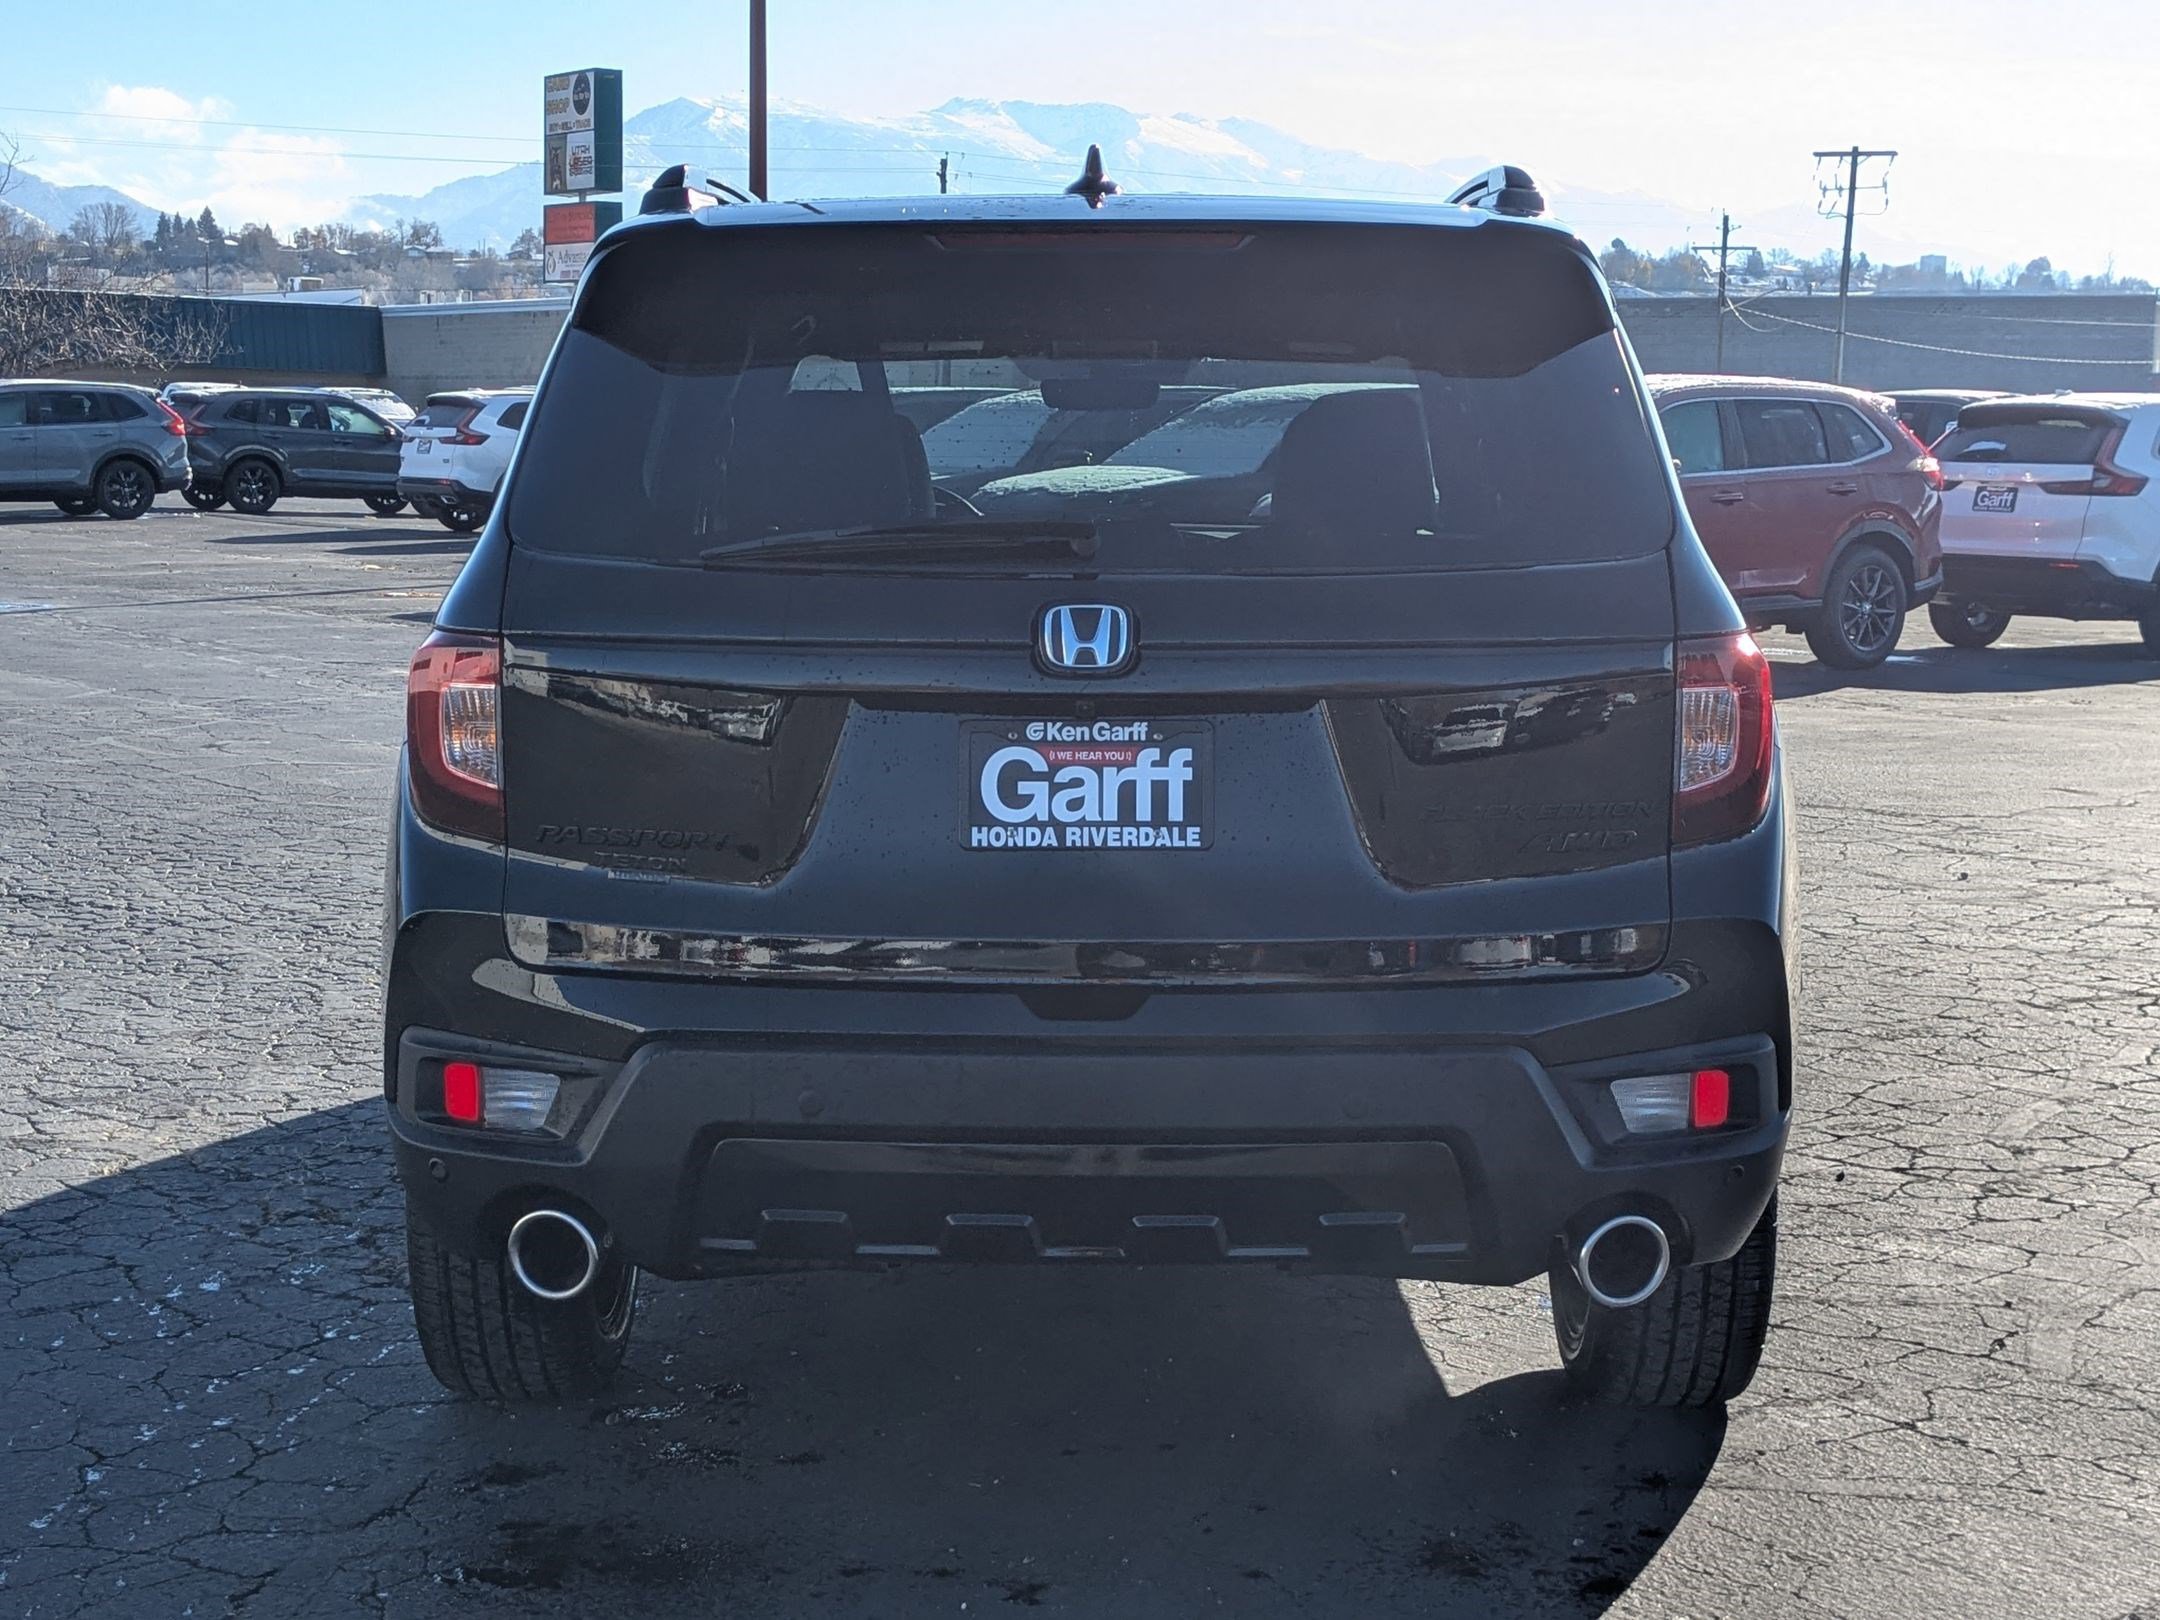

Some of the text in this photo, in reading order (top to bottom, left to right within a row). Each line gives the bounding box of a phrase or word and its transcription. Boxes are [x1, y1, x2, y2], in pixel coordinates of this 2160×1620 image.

[571, 144, 590, 155] UTAH
[1977, 491, 2014, 506] Garff
[1046, 722, 1148, 741] Ken Garff
[1058, 751, 1125, 761] WE HEAR YOU
[980, 746, 1193, 823] Garff
[536, 824, 733, 851] PASSPORT
[971, 827, 1200, 847] HONDA RIVERDALE
